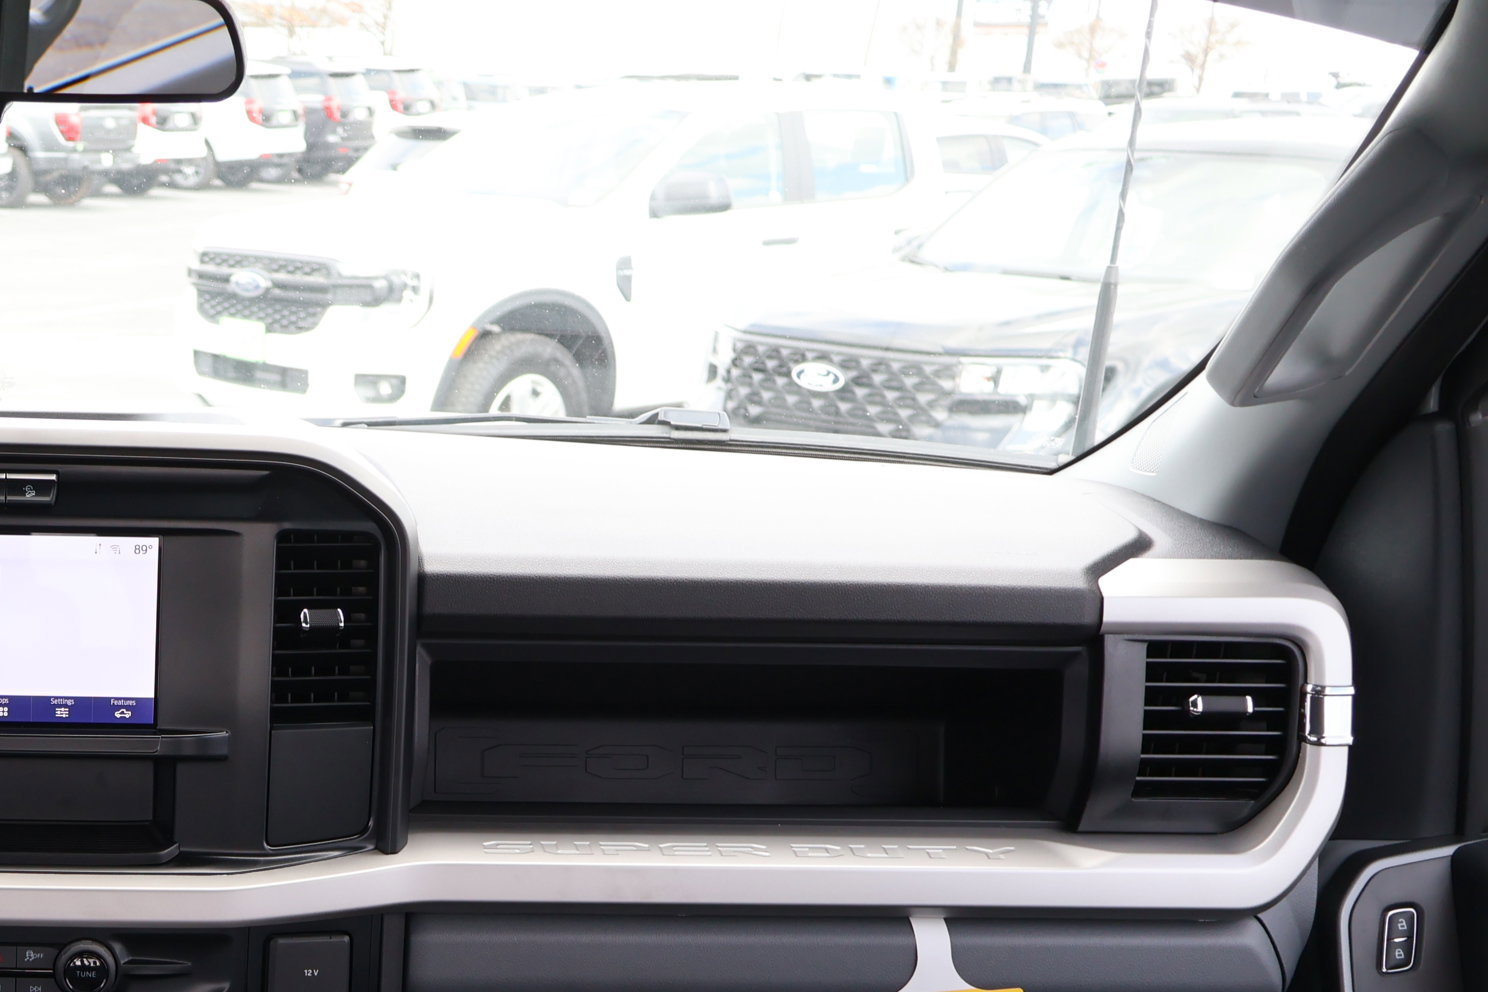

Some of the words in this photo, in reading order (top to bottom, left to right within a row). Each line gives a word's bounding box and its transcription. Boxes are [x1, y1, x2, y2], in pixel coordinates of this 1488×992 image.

[134, 544, 153, 555] 89°
[50, 697, 75, 707] Settings
[111, 698, 136, 706] Features
[481, 743, 874, 782] FORD
[482, 839, 771, 860] SUPER
[790, 842, 1016, 861] DUTY
[76, 970, 97, 978] TUNE
[304, 969, 313, 977] 12
